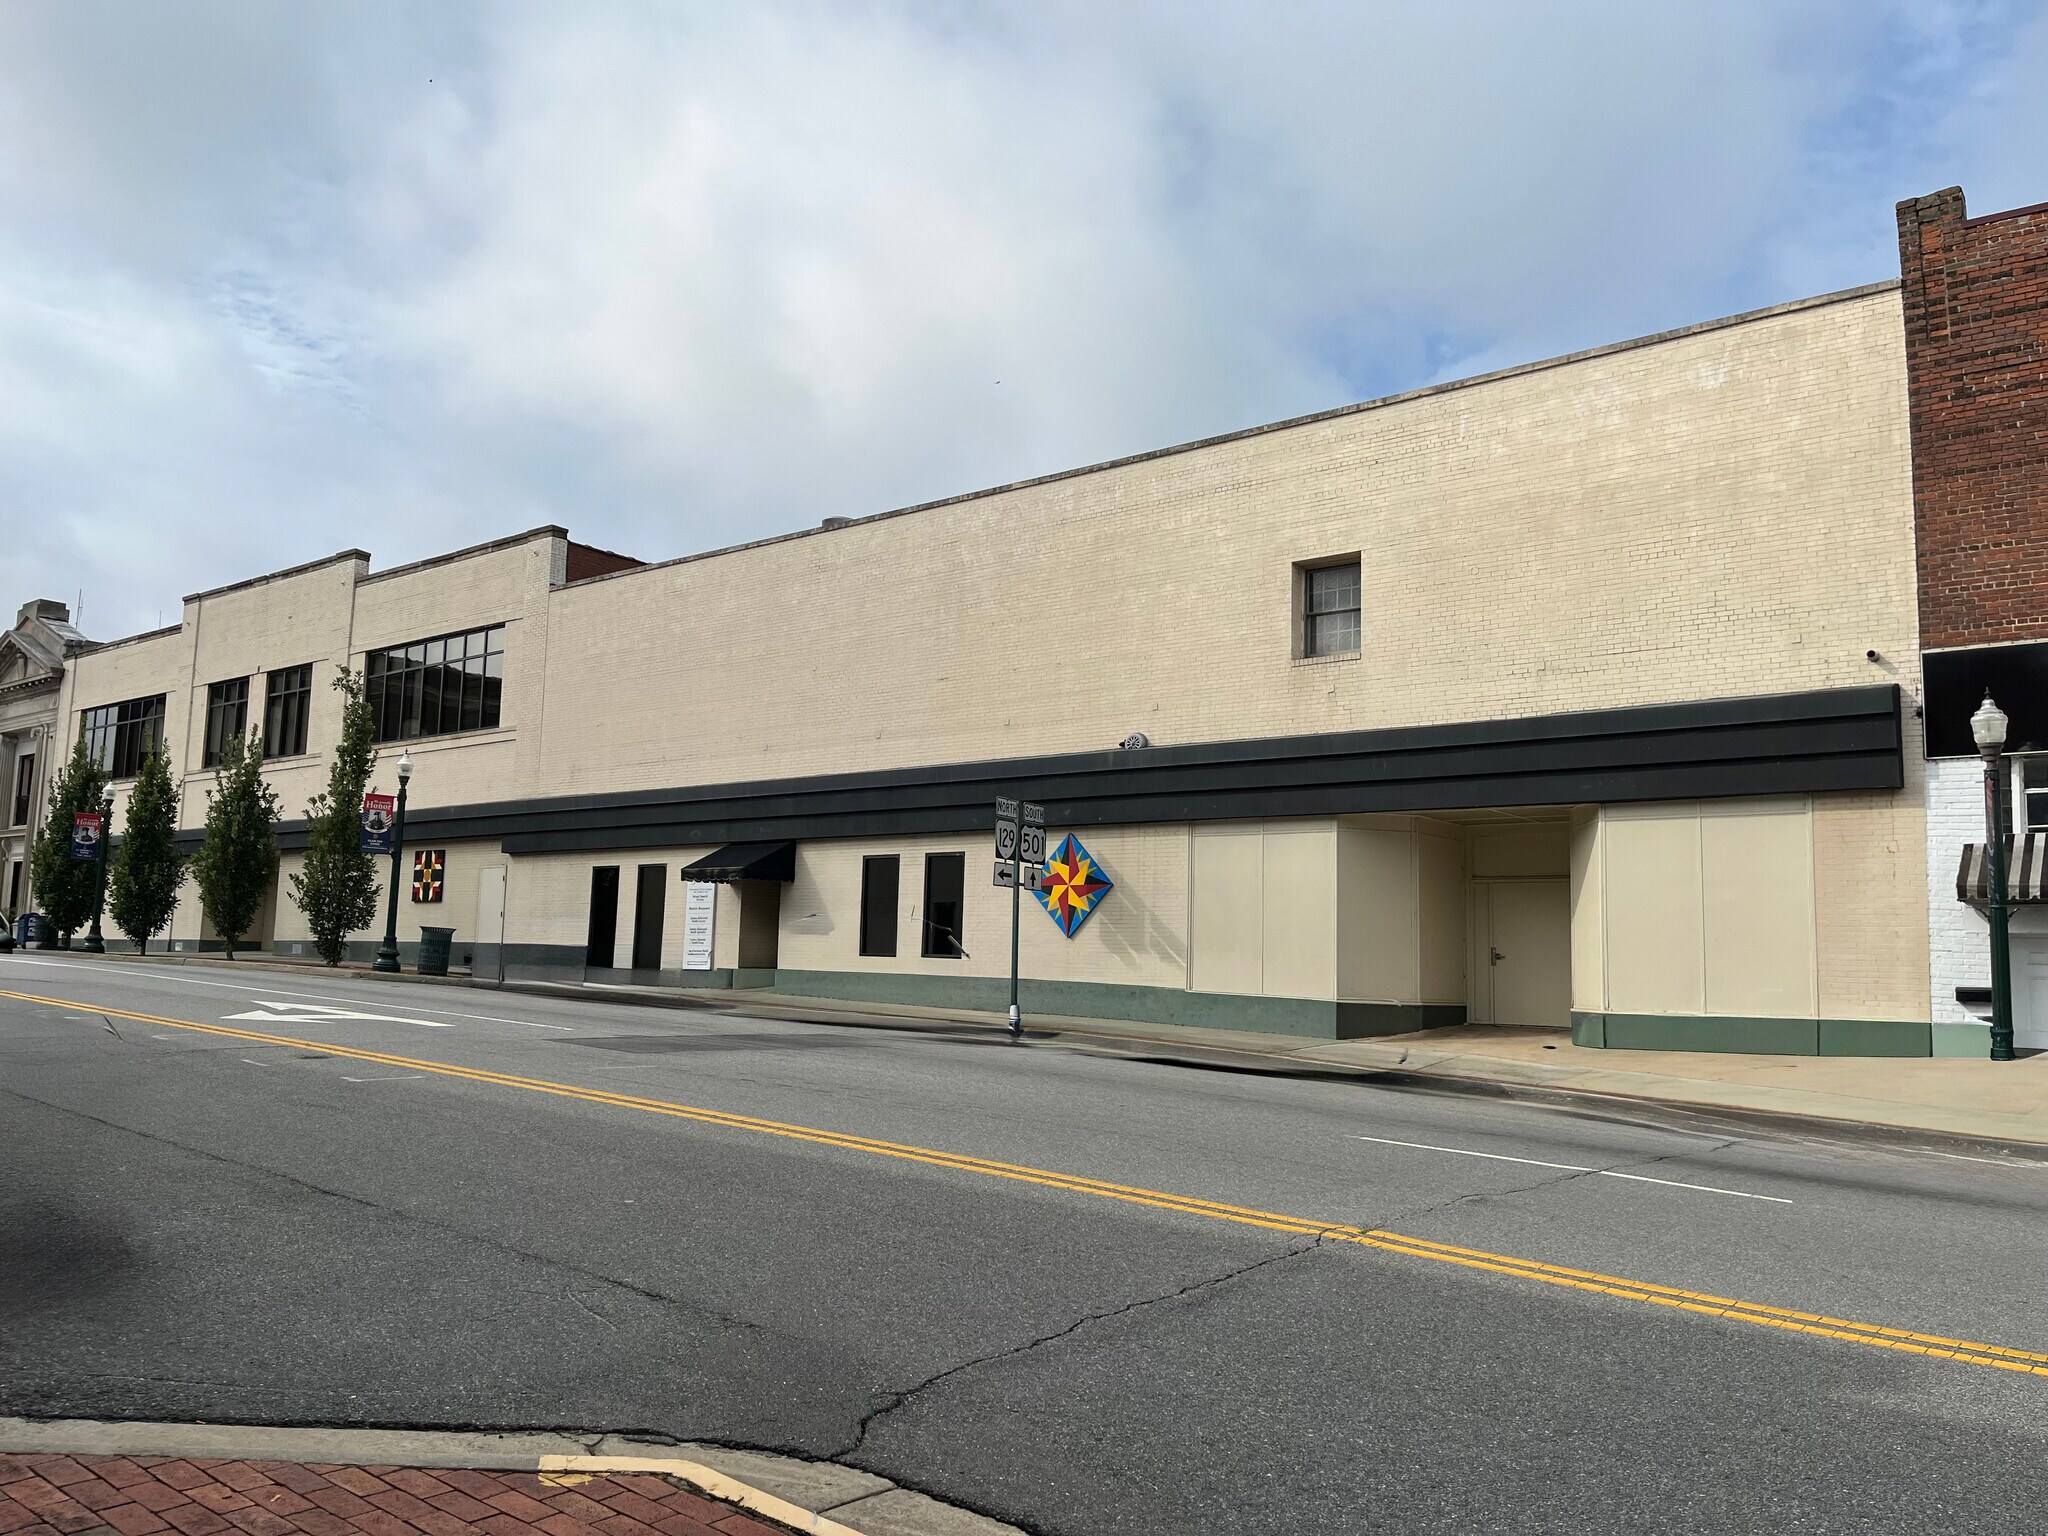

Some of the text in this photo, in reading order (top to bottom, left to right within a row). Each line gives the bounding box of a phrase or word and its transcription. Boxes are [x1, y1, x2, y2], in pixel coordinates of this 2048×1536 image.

[366, 800, 392, 811] Honor
[998, 799, 1017, 815] NORTH
[1025, 805, 1044, 820] SOUTH
[76, 818, 99, 827] Honor
[998, 827, 1015, 849] 129
[1022, 832, 1045, 856] 501
